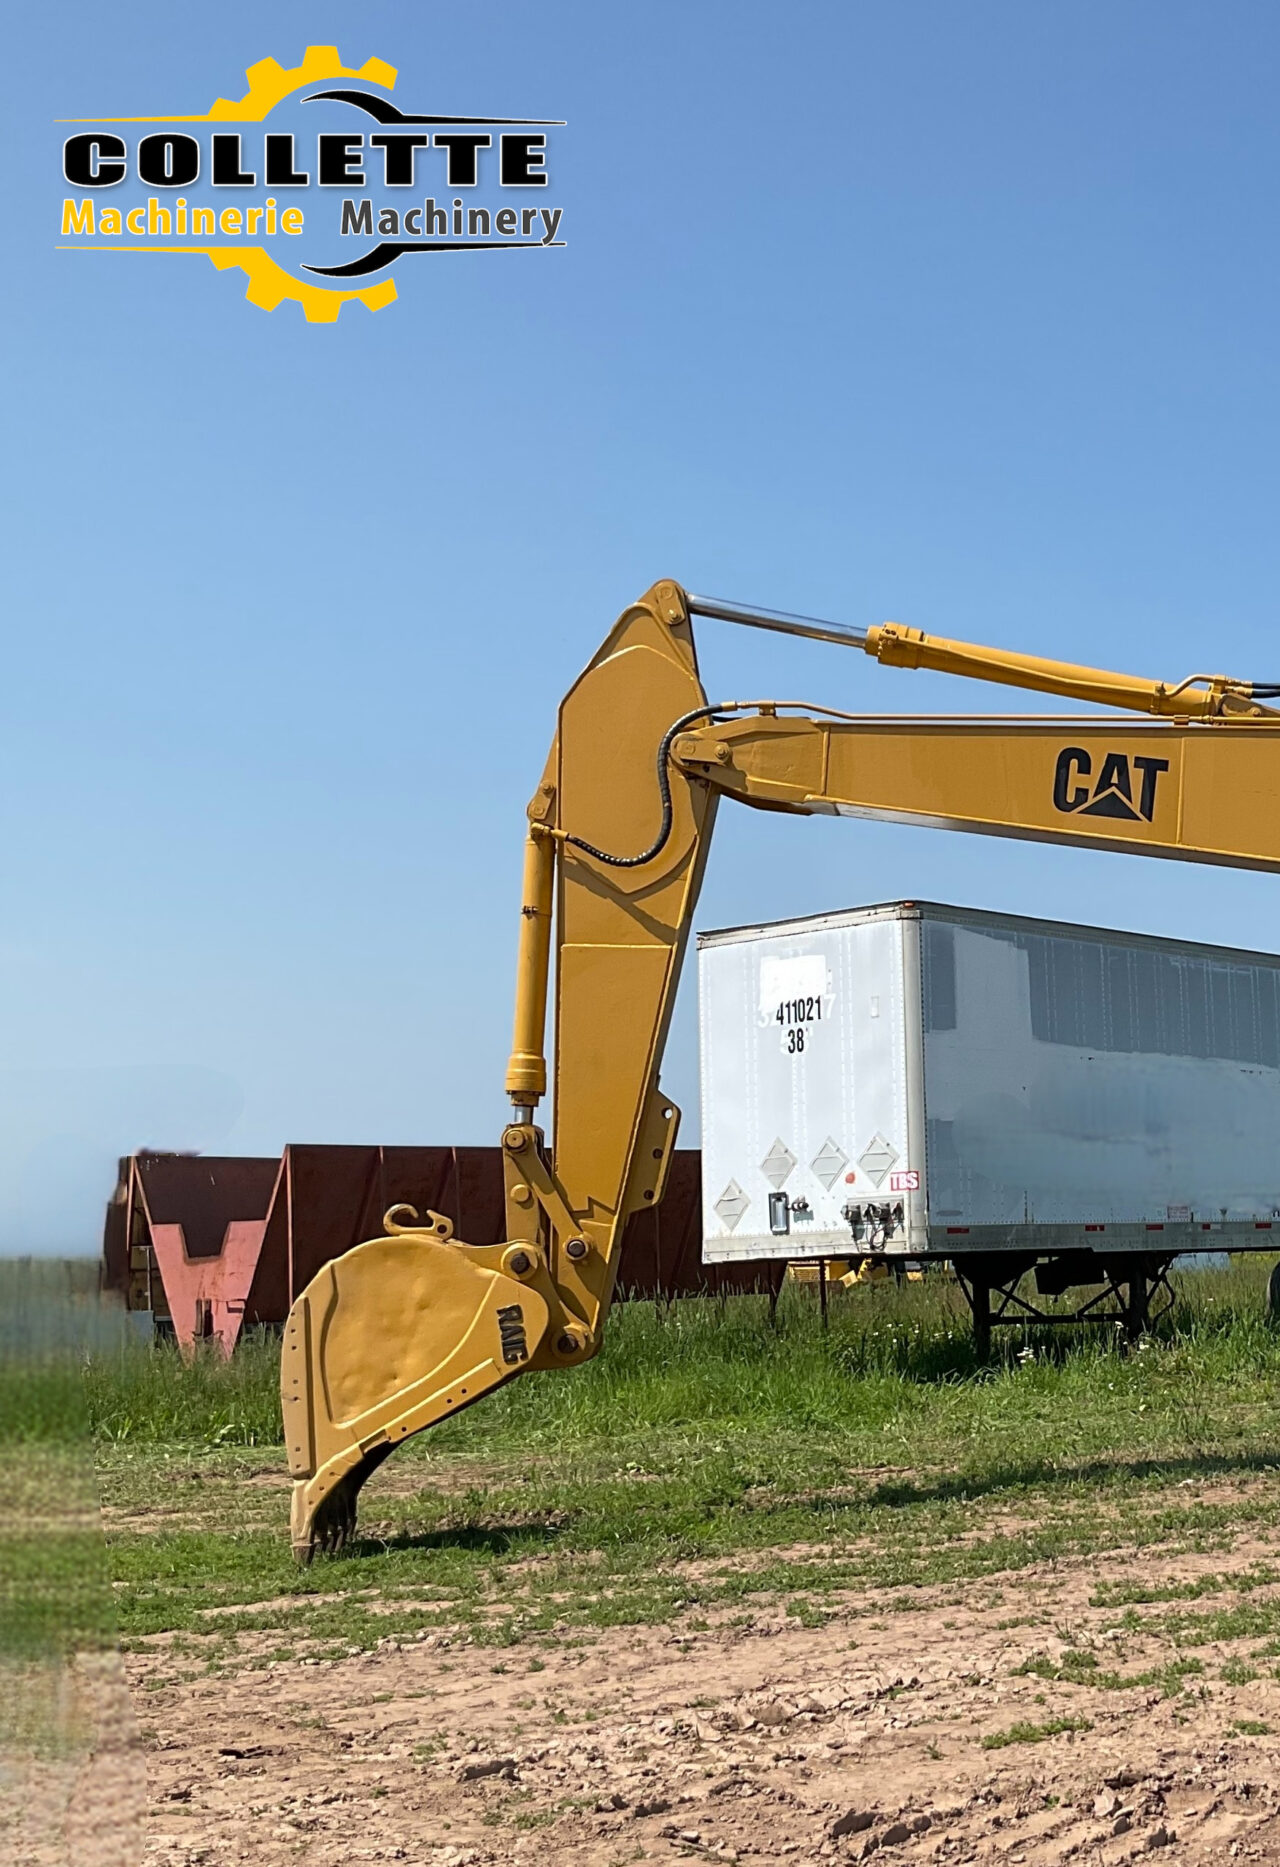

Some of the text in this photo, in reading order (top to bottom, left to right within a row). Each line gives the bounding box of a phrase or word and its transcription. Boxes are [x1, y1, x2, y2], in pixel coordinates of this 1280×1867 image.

[1053, 746, 1169, 823] CAT
[776, 995, 821, 1025] 411021
[890, 1171, 920, 1191] TBS
